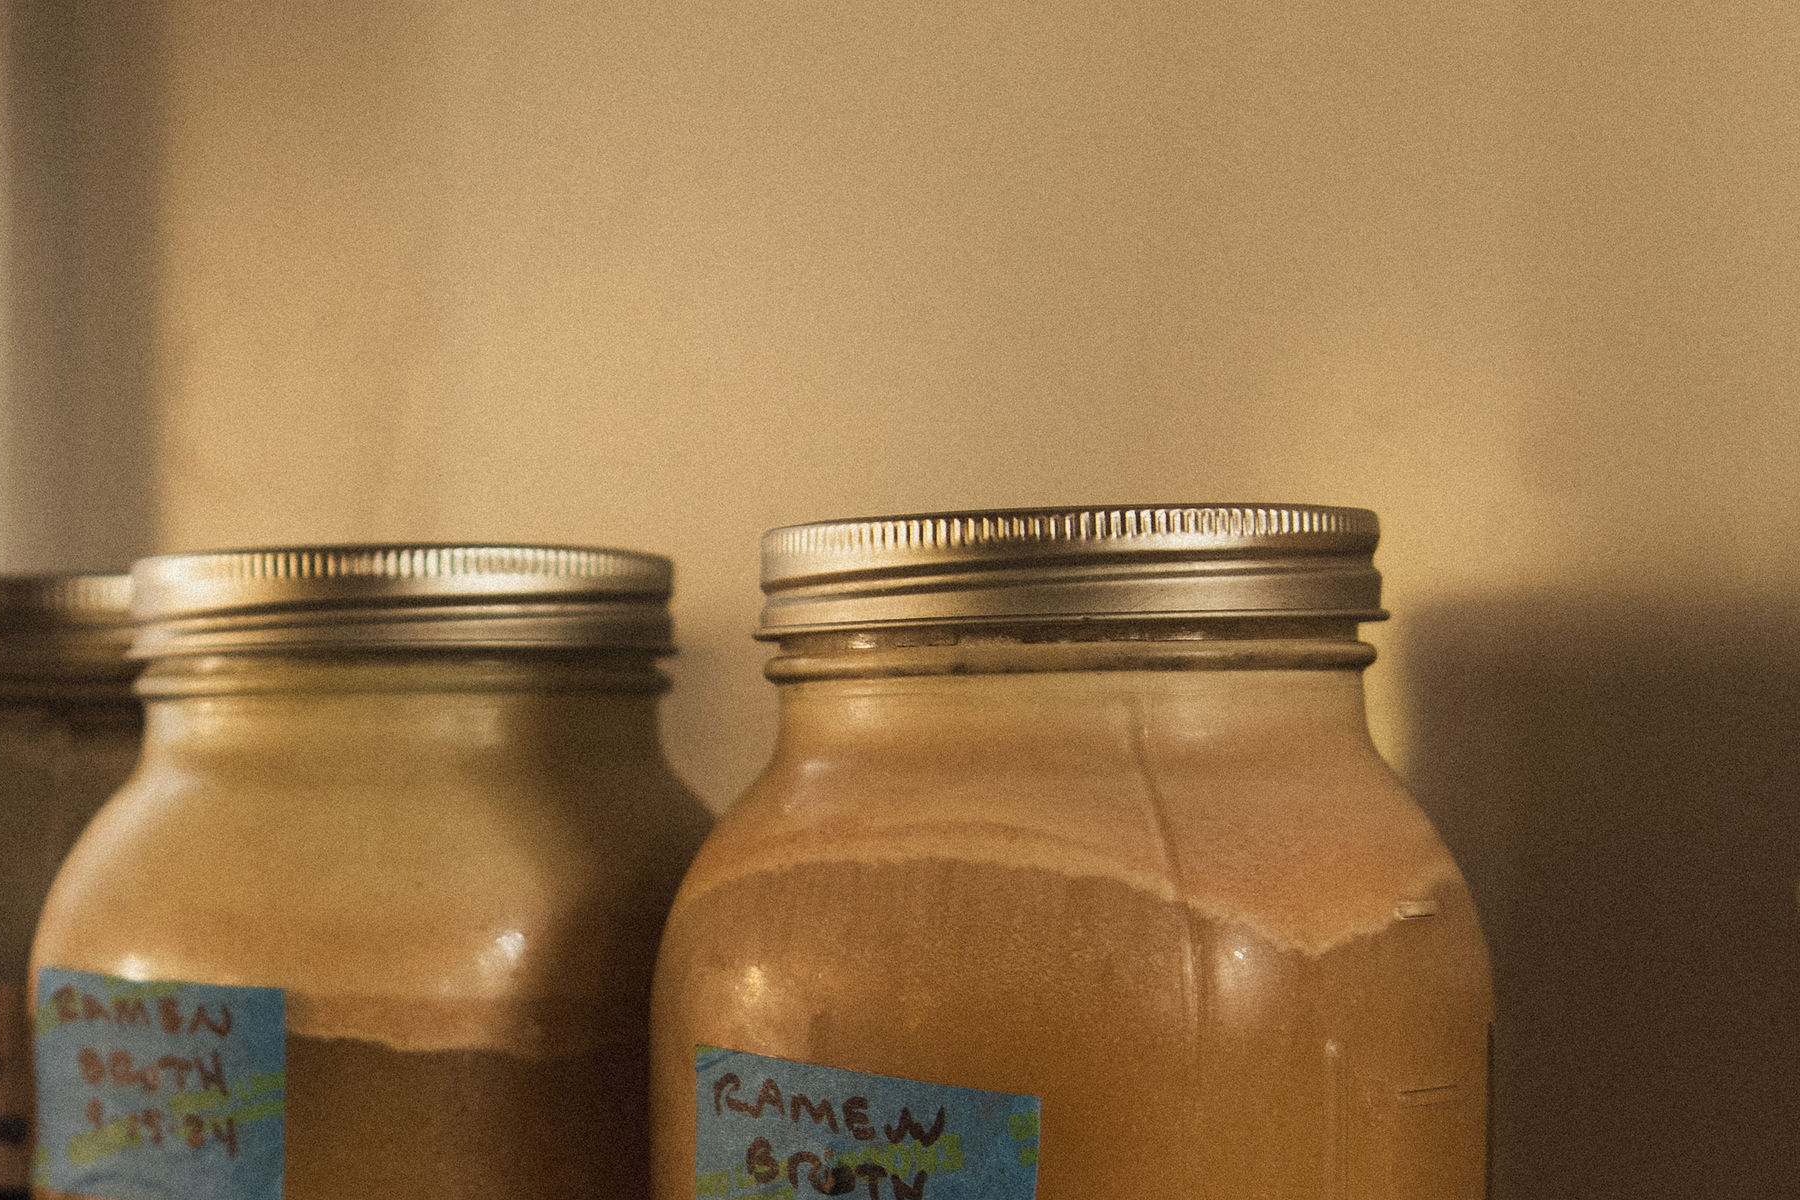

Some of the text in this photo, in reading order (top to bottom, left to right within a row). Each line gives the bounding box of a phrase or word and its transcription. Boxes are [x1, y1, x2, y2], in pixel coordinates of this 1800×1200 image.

[53, 984, 233, 1038] RAMEN
[77, 1046, 231, 1097] BROTH
[713, 1072, 946, 1147] RAMEN
